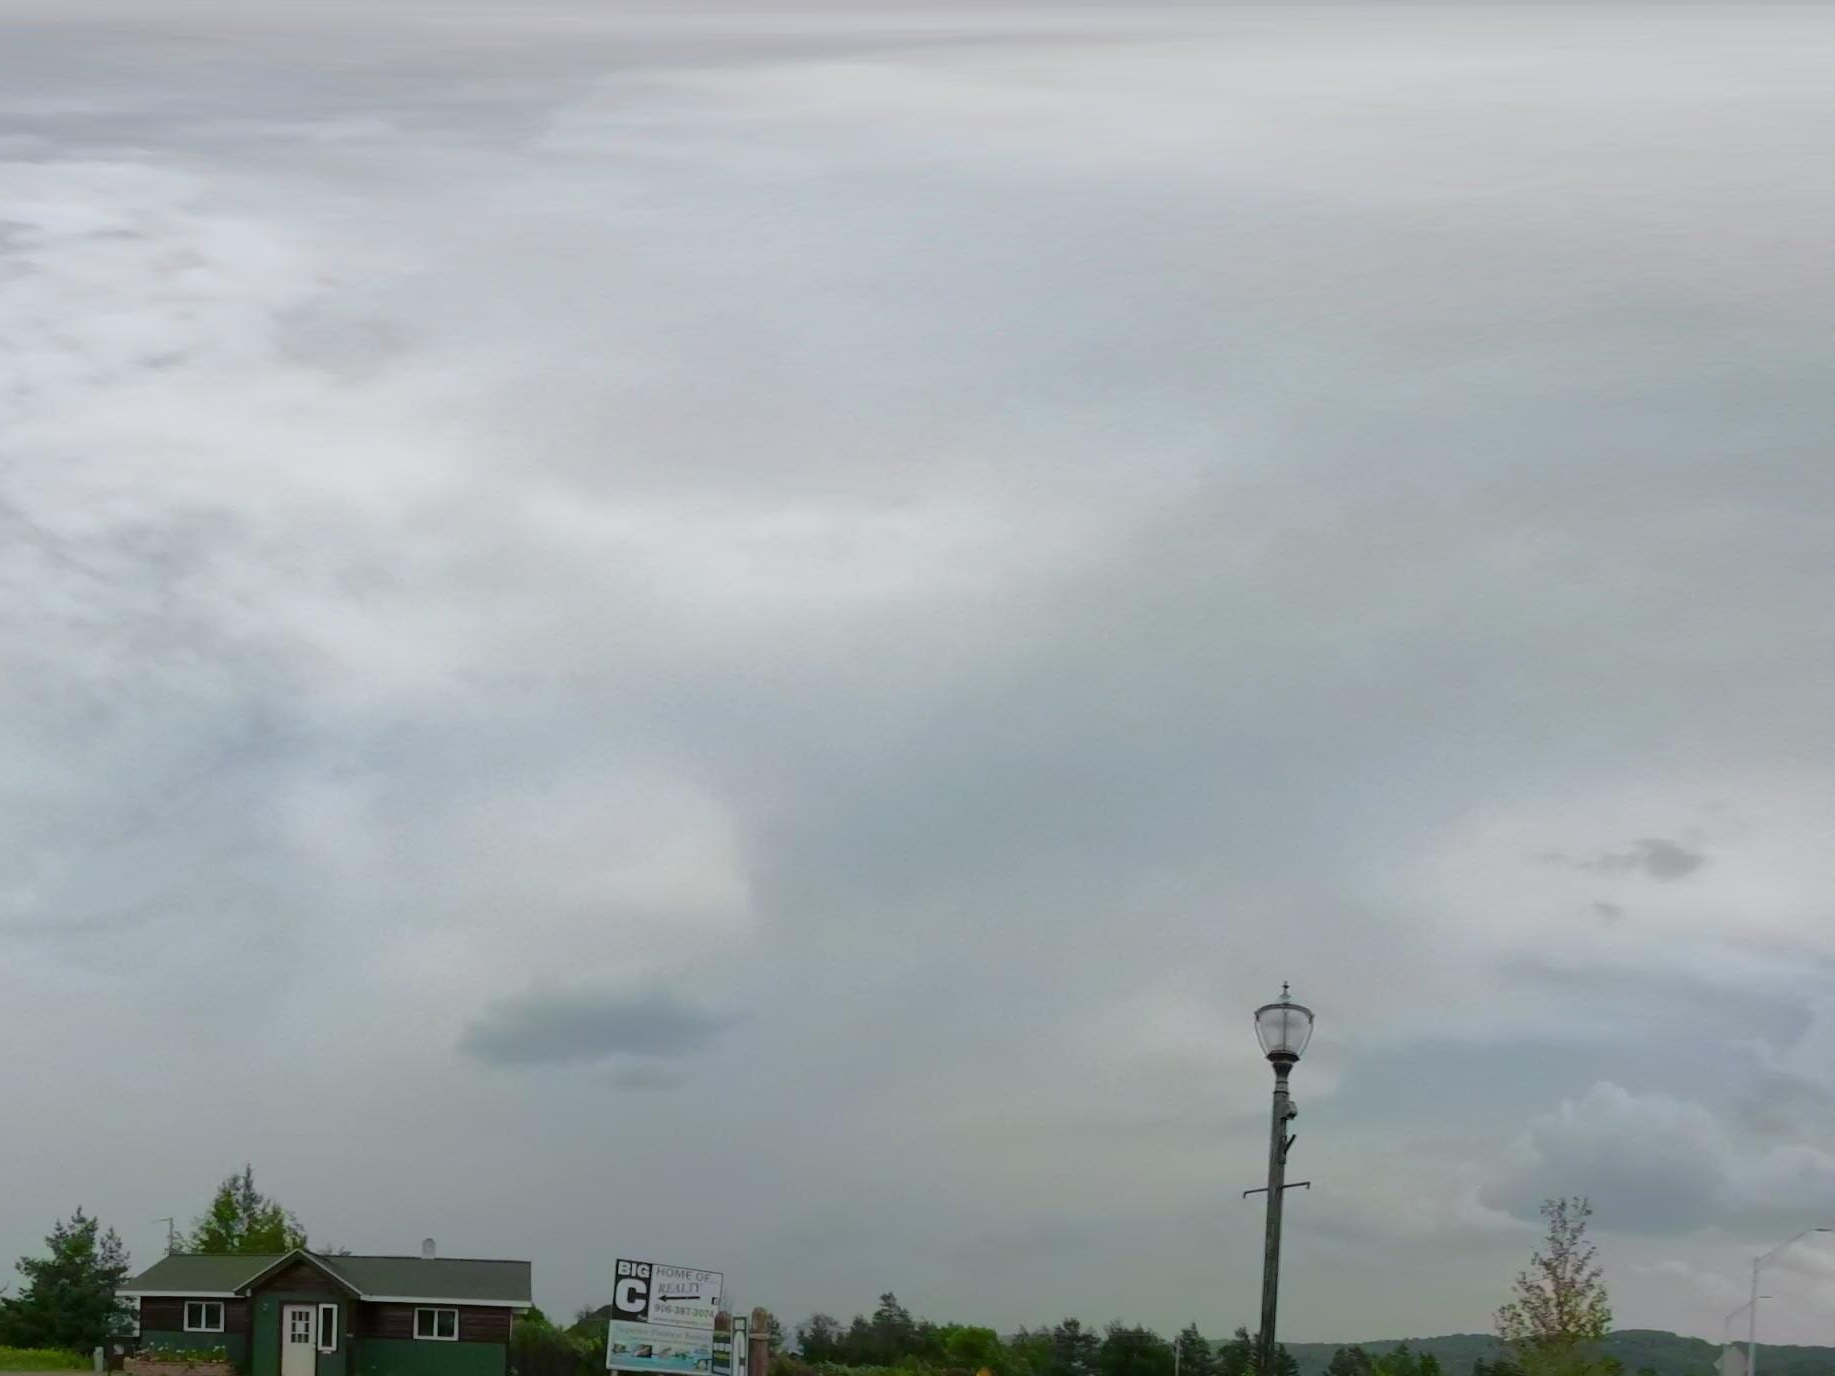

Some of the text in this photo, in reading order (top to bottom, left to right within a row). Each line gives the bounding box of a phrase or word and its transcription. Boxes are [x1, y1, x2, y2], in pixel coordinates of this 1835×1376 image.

[618, 1261, 650, 1278] BIG
[656, 1267, 692, 1280] HOME
[615, 1278, 647, 1312] C
[658, 1283, 700, 1294] REALTY
